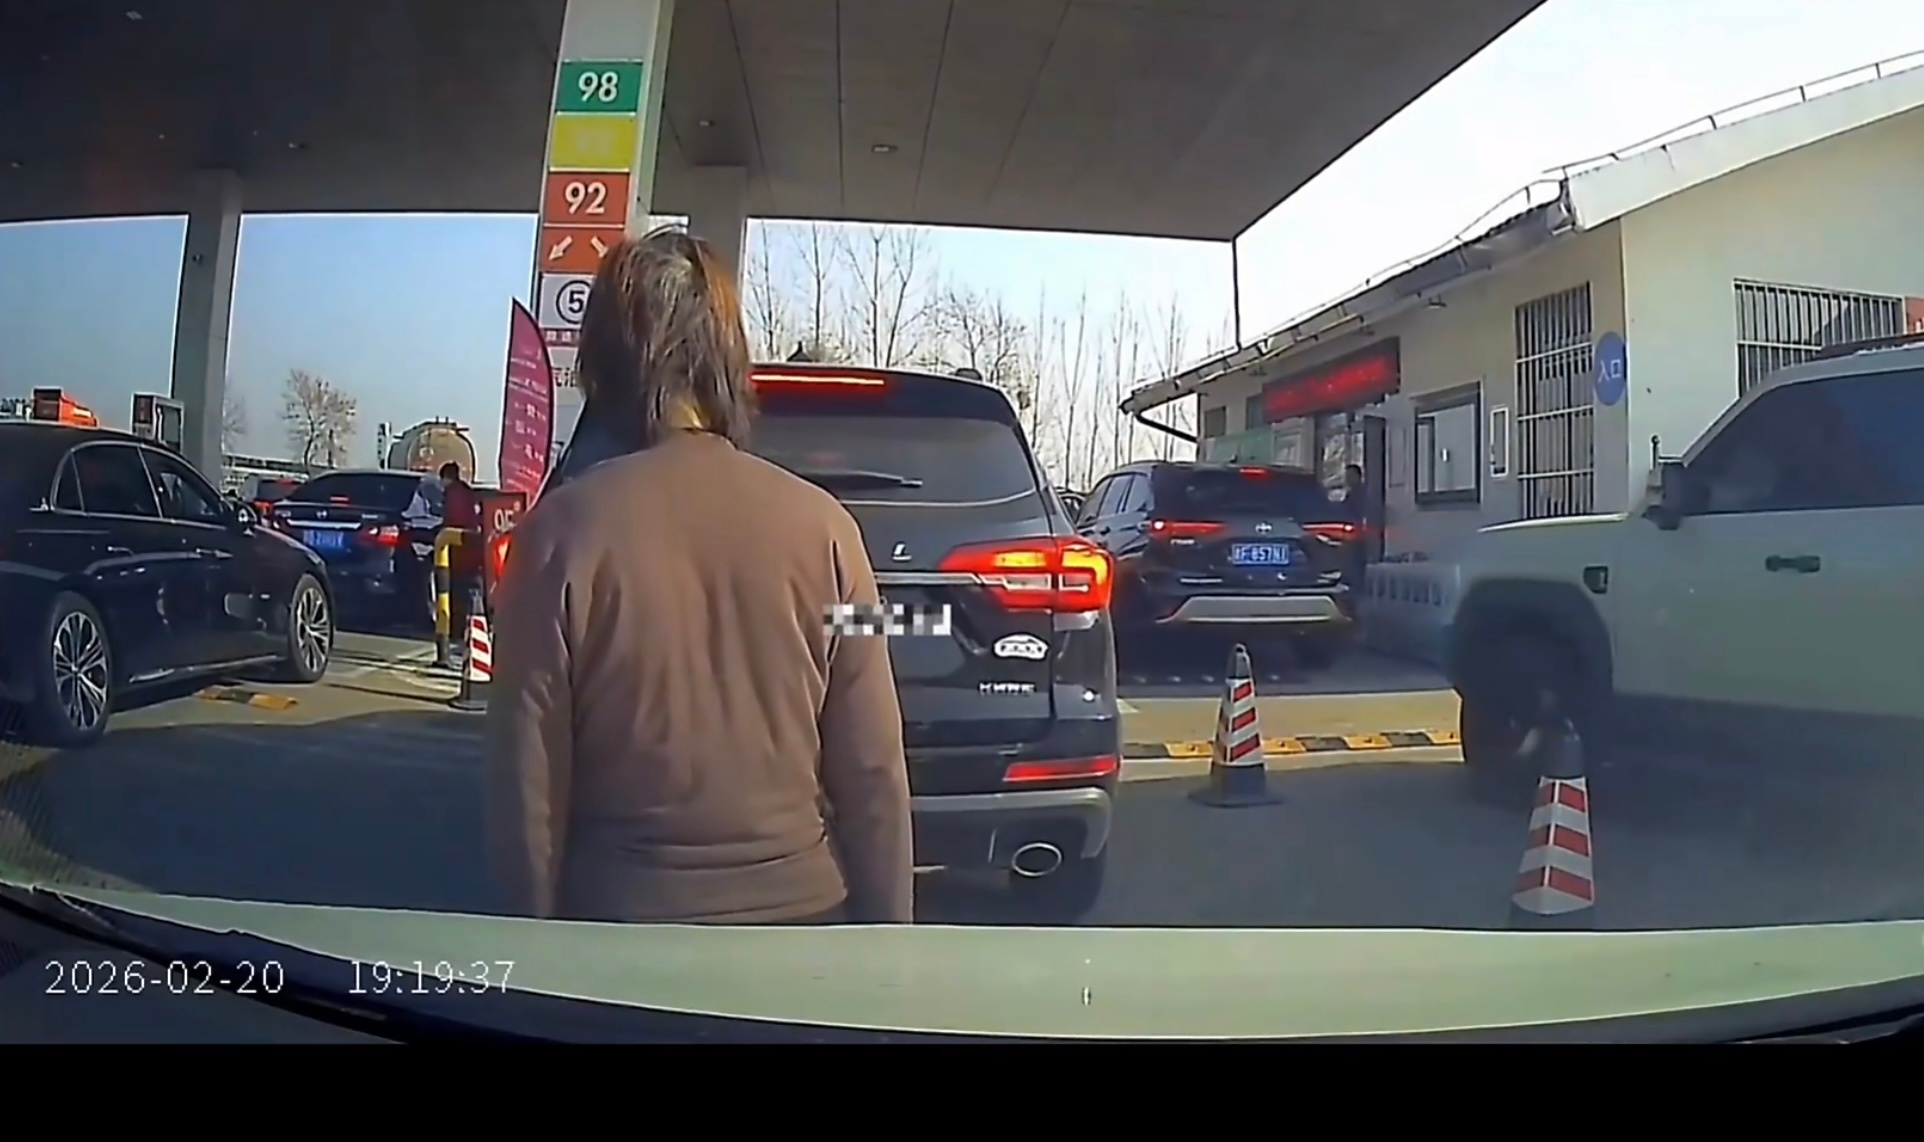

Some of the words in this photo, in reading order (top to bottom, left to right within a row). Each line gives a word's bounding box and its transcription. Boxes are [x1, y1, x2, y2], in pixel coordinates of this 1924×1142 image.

[578, 71, 619, 103] 98
[564, 182, 607, 215] 92
[1598, 359, 1621, 382] 入口
